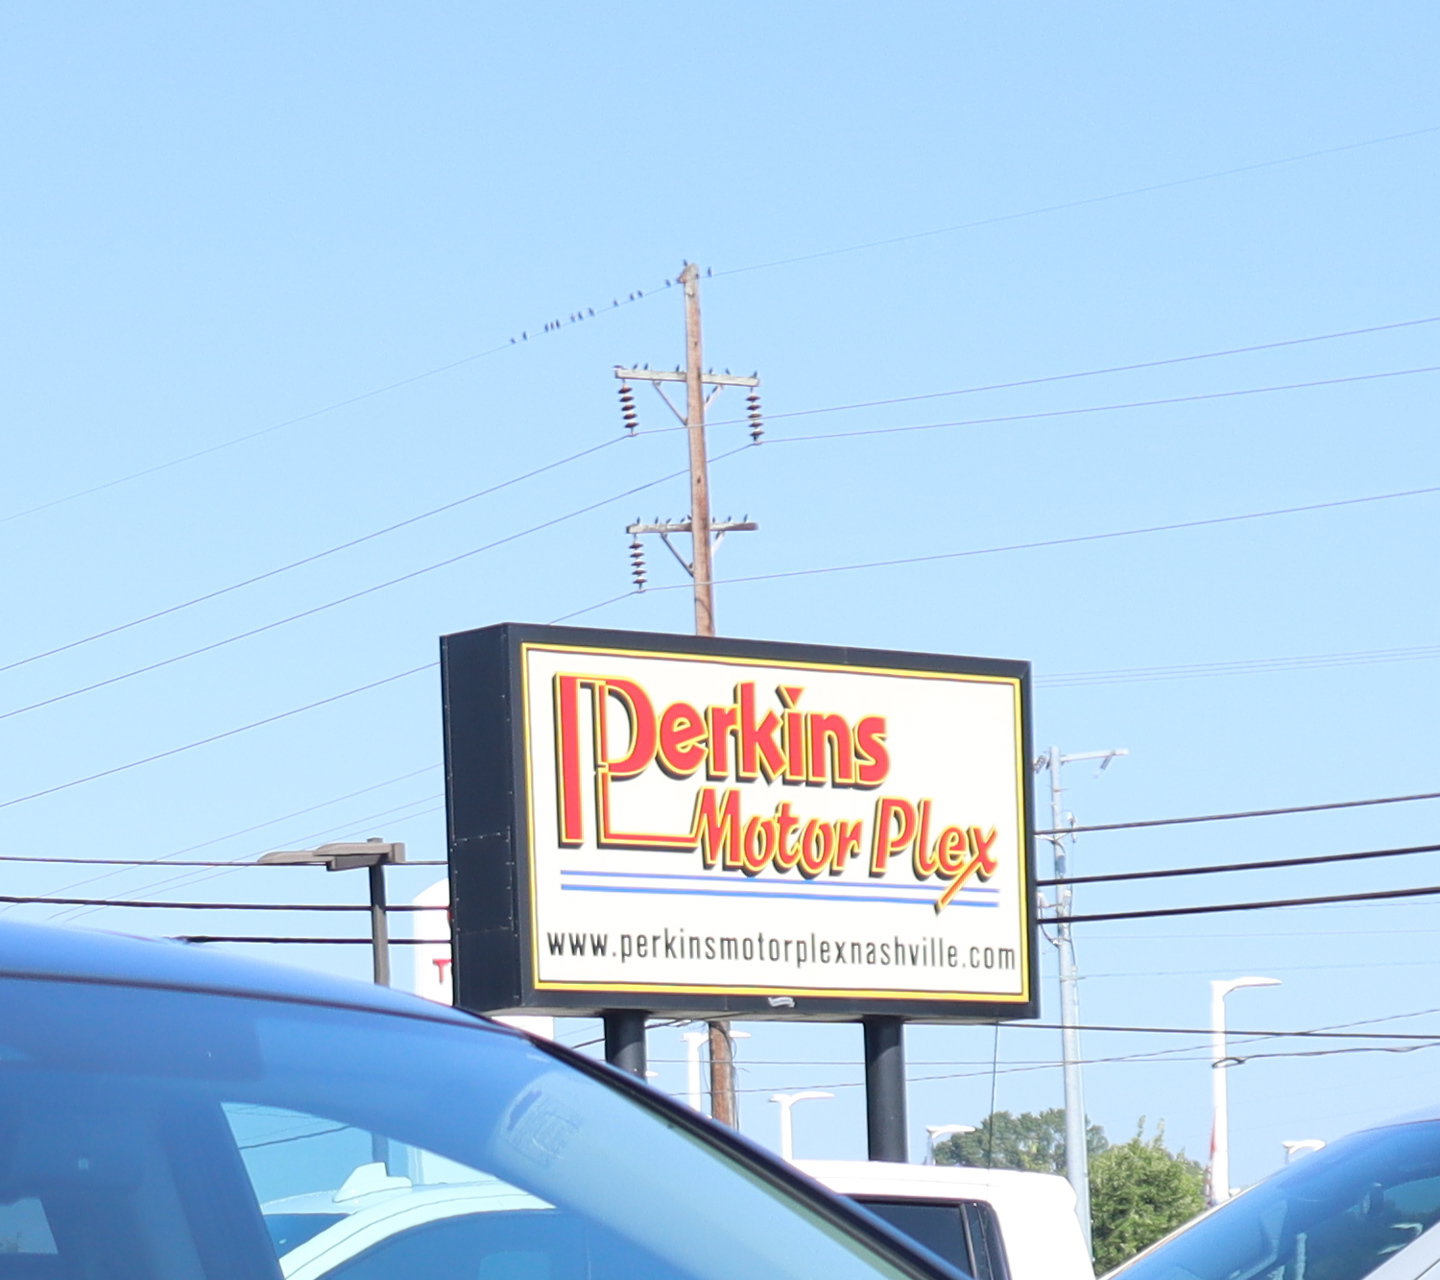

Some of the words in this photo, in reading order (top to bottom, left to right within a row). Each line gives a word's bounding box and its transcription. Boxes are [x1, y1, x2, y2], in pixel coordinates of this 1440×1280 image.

[553, 672, 891, 849] Perkins
[688, 786, 864, 880] Motor
[869, 796, 998, 914] Plex
[546, 927, 1017, 969] www.perkinsmotorplexnashville.com
